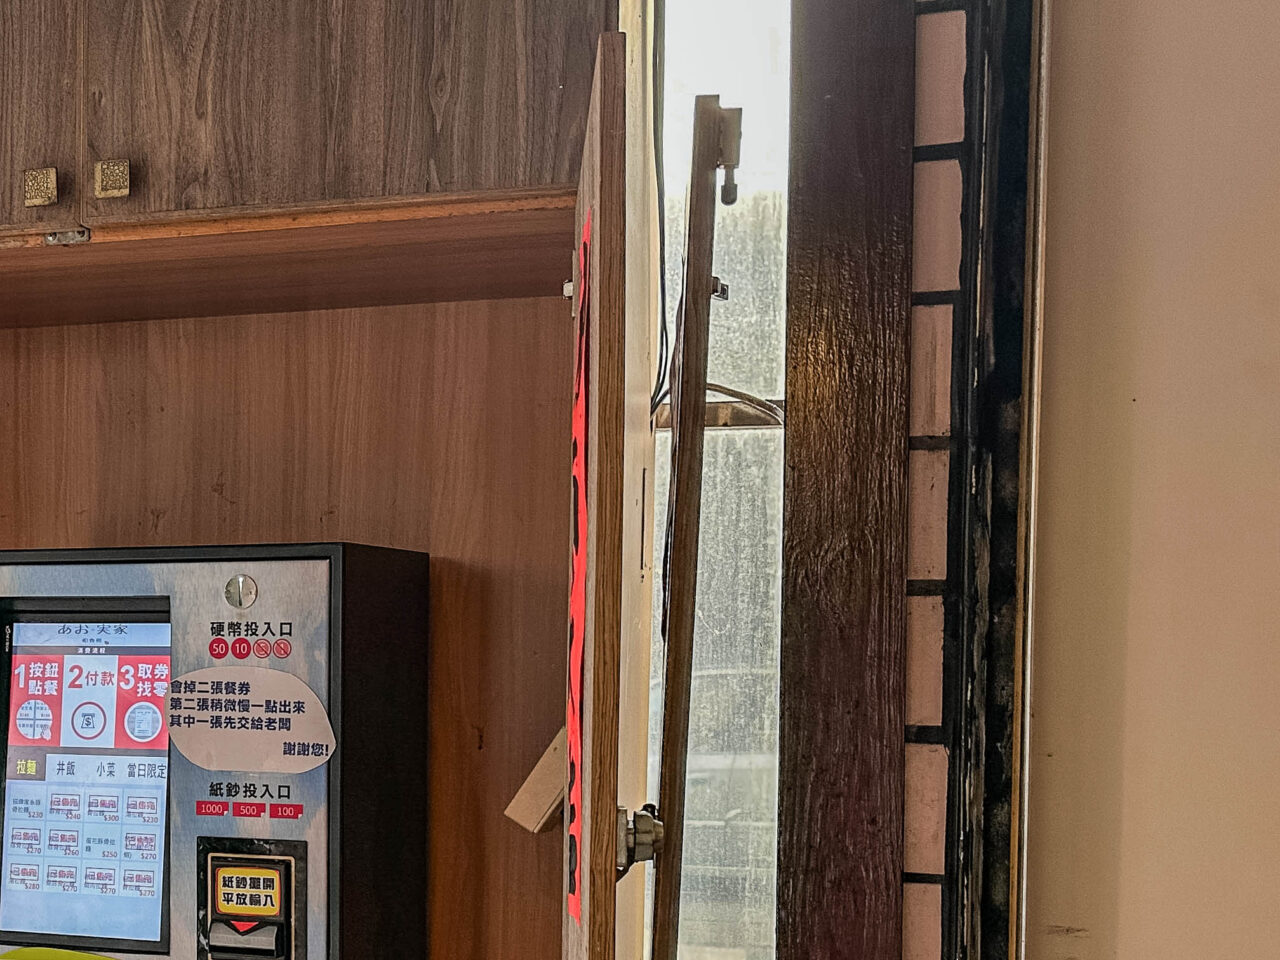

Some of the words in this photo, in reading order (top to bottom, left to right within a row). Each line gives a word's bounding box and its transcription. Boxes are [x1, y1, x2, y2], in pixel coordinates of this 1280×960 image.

[210, 622, 292, 637] 硬幣投入口
[212, 643, 226, 654] 50
[235, 643, 248, 654] 10
[14, 664, 25, 688] 1
[29, 662, 59, 678] 按鈕
[68, 664, 84, 689] 2
[85, 671, 115, 686] 付款
[119, 665, 135, 690] 3
[137, 663, 168, 679] 取券
[28, 680, 58, 696] 點餐
[137, 681, 168, 697] 找零
[170, 680, 251, 695] 會掉二張餐券
[169, 697, 306, 714] 第二張稍微慢一點出來
[169, 714, 291, 731] 其中一張先交給老闆
[283, 742, 329, 757] 謝謝您!
[16, 760, 37, 775] 拉麵
[96, 761, 116, 777] 小菜
[127, 763, 167, 779] 當日限定
[209, 782, 291, 799] 紙鈔投入口
[201, 804, 222, 814] 1000
[239, 805, 257, 815] 500
[277, 807, 294, 816] 100
[222, 875, 275, 891] 紙鈔攤開
